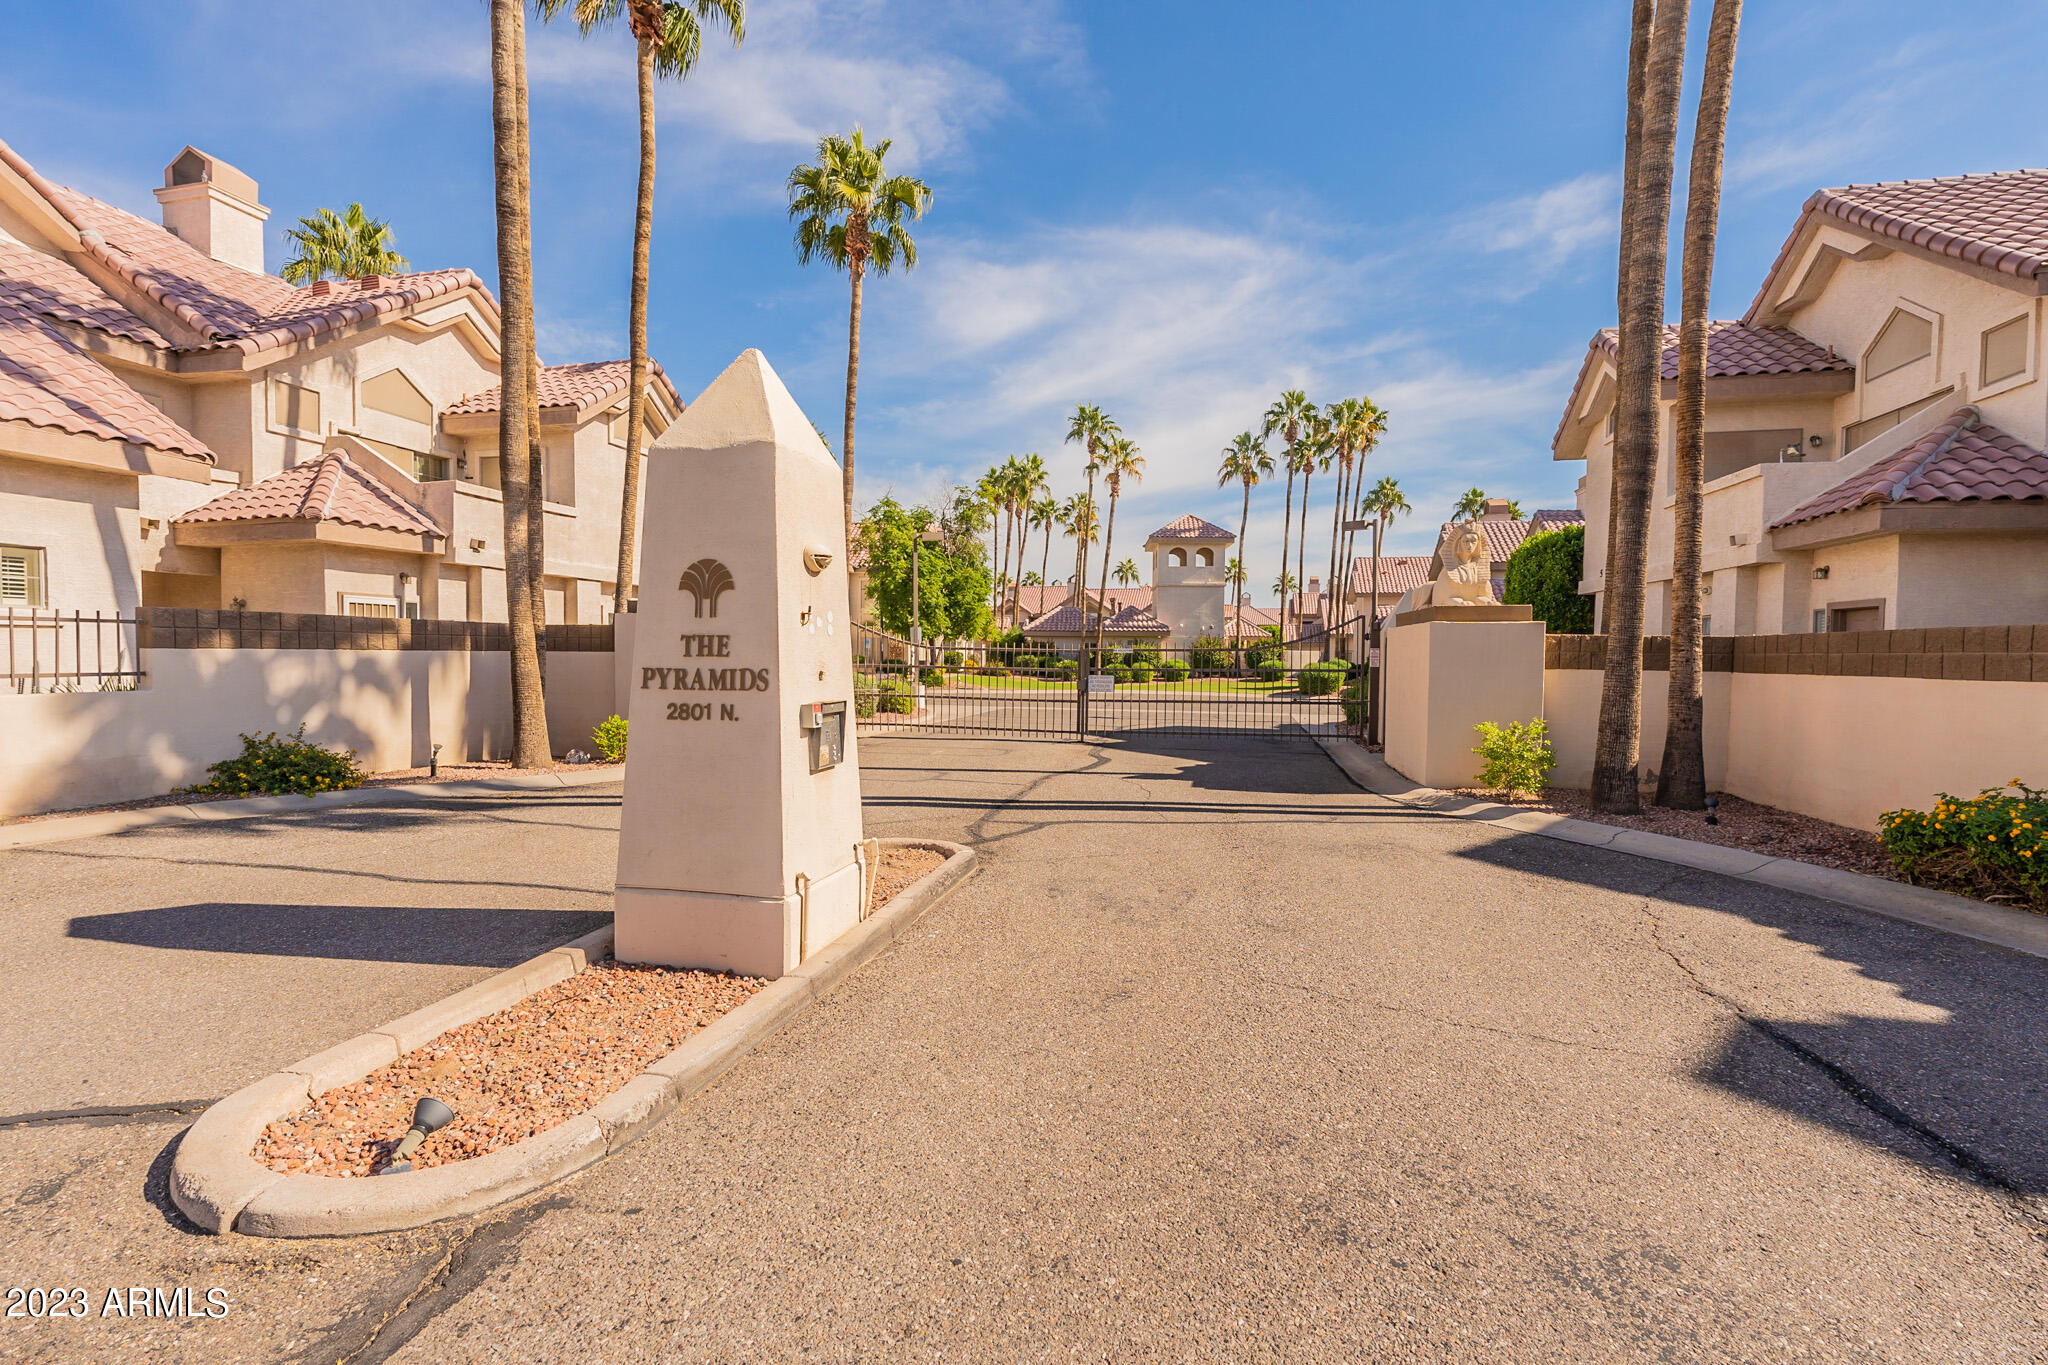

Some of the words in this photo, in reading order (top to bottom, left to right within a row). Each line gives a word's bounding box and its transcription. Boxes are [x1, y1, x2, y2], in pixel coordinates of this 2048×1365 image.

[680, 634, 730, 657] THE
[640, 667, 769, 692] PYRAMIDS
[666, 702, 712, 721] 2801
[720, 704, 740, 722] N.
